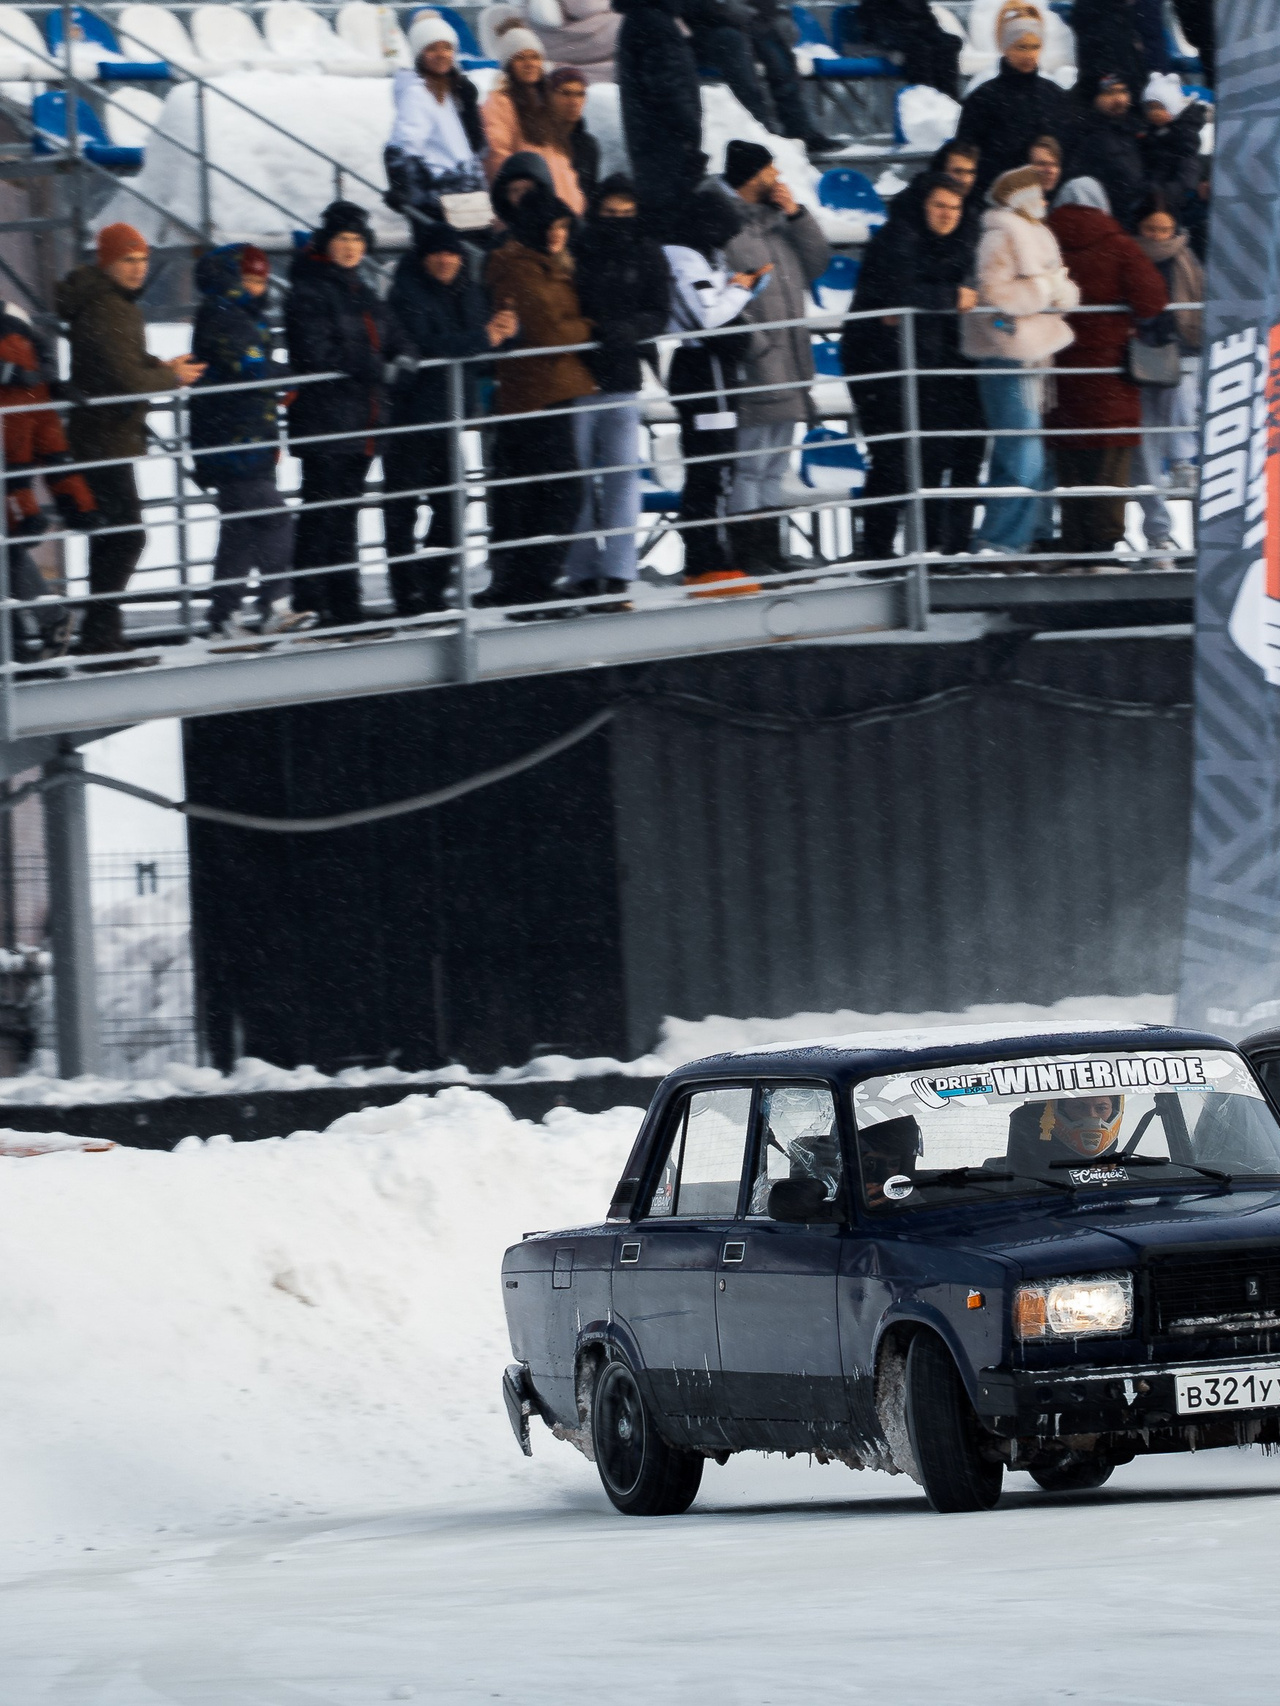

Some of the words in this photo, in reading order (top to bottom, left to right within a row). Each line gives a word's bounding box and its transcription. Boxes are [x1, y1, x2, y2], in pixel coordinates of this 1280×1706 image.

[935, 1073, 990, 1091] DRIFT
[991, 1061, 1115, 1095] WINTER
[1116, 1057, 1206, 1087] MODE
[964, 1086, 987, 1094] EXPO
